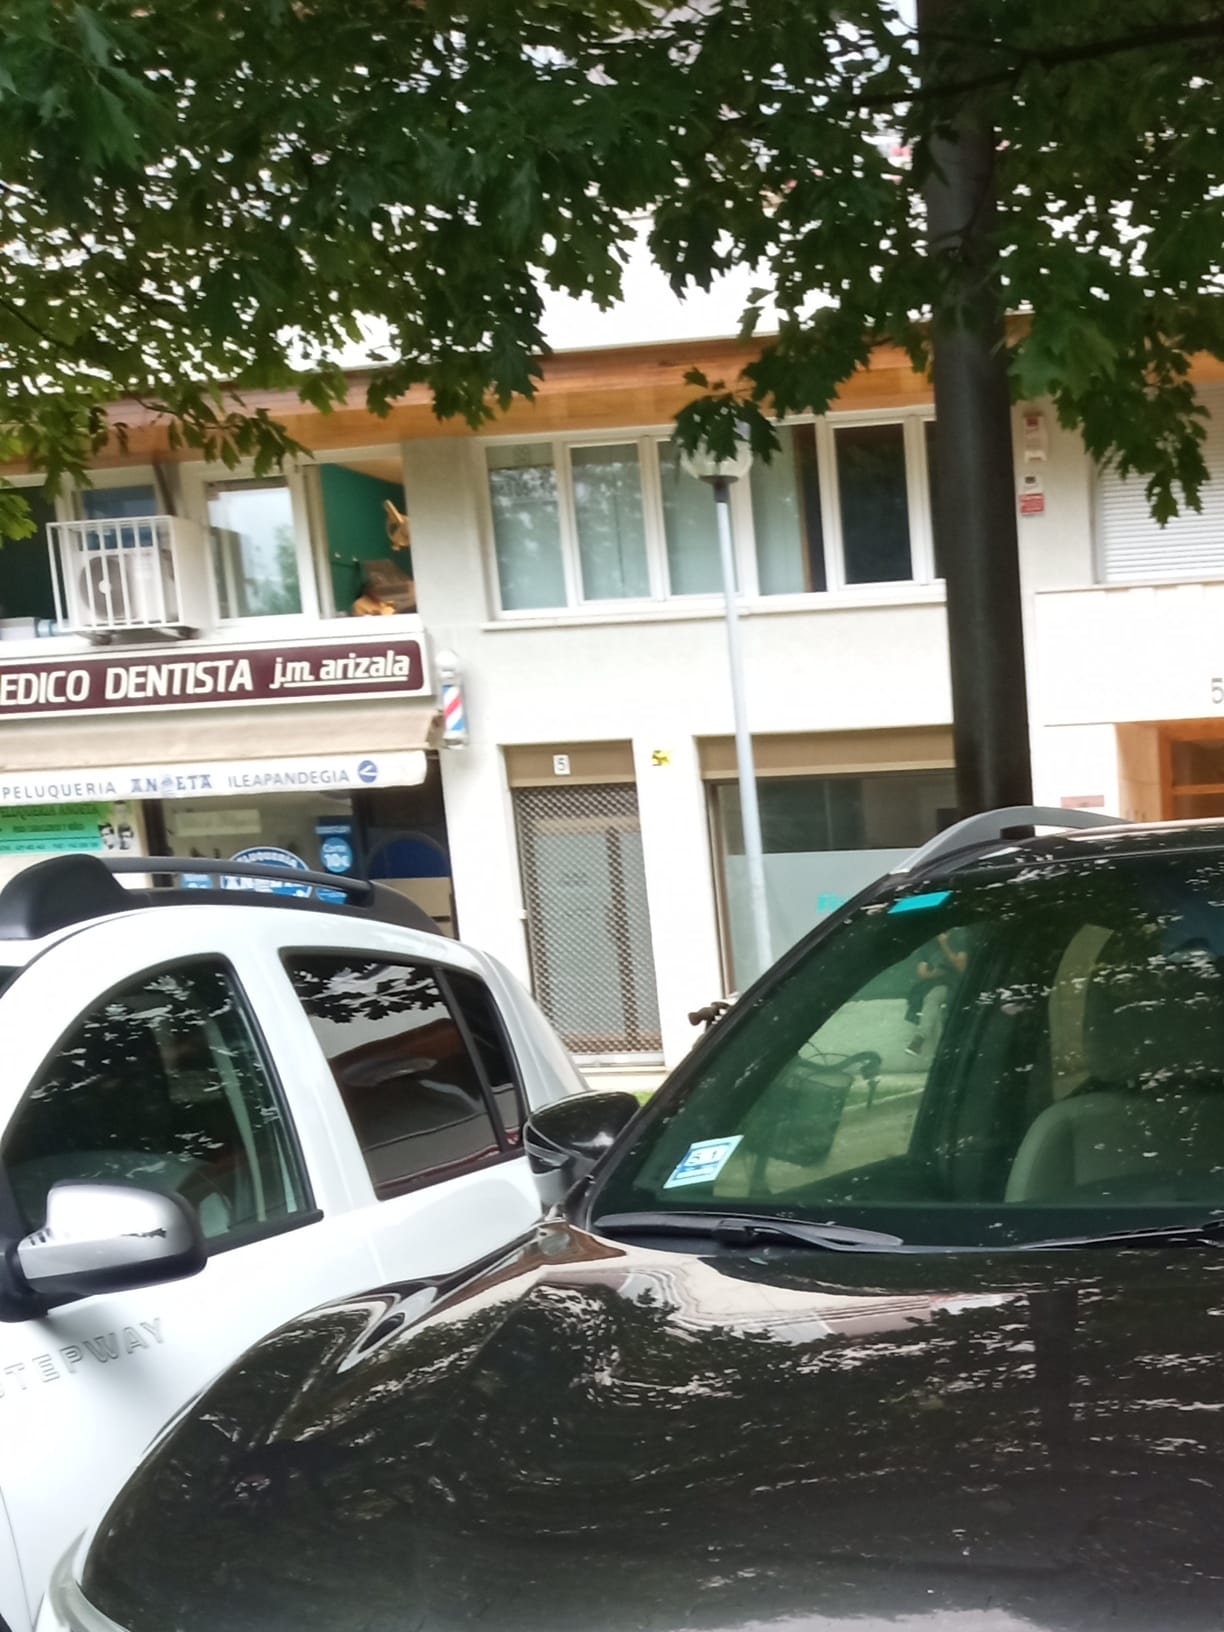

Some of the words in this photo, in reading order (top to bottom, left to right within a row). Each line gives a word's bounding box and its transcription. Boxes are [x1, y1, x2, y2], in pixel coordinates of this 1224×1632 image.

[105, 658, 254, 700] DENTISTA
[319, 649, 410, 680] arizala
[1210, 677, 1224, 705] 5
[2, 780, 118, 799] PELUQUERIA
[227, 768, 350, 789] ILEAPANDEGIA
